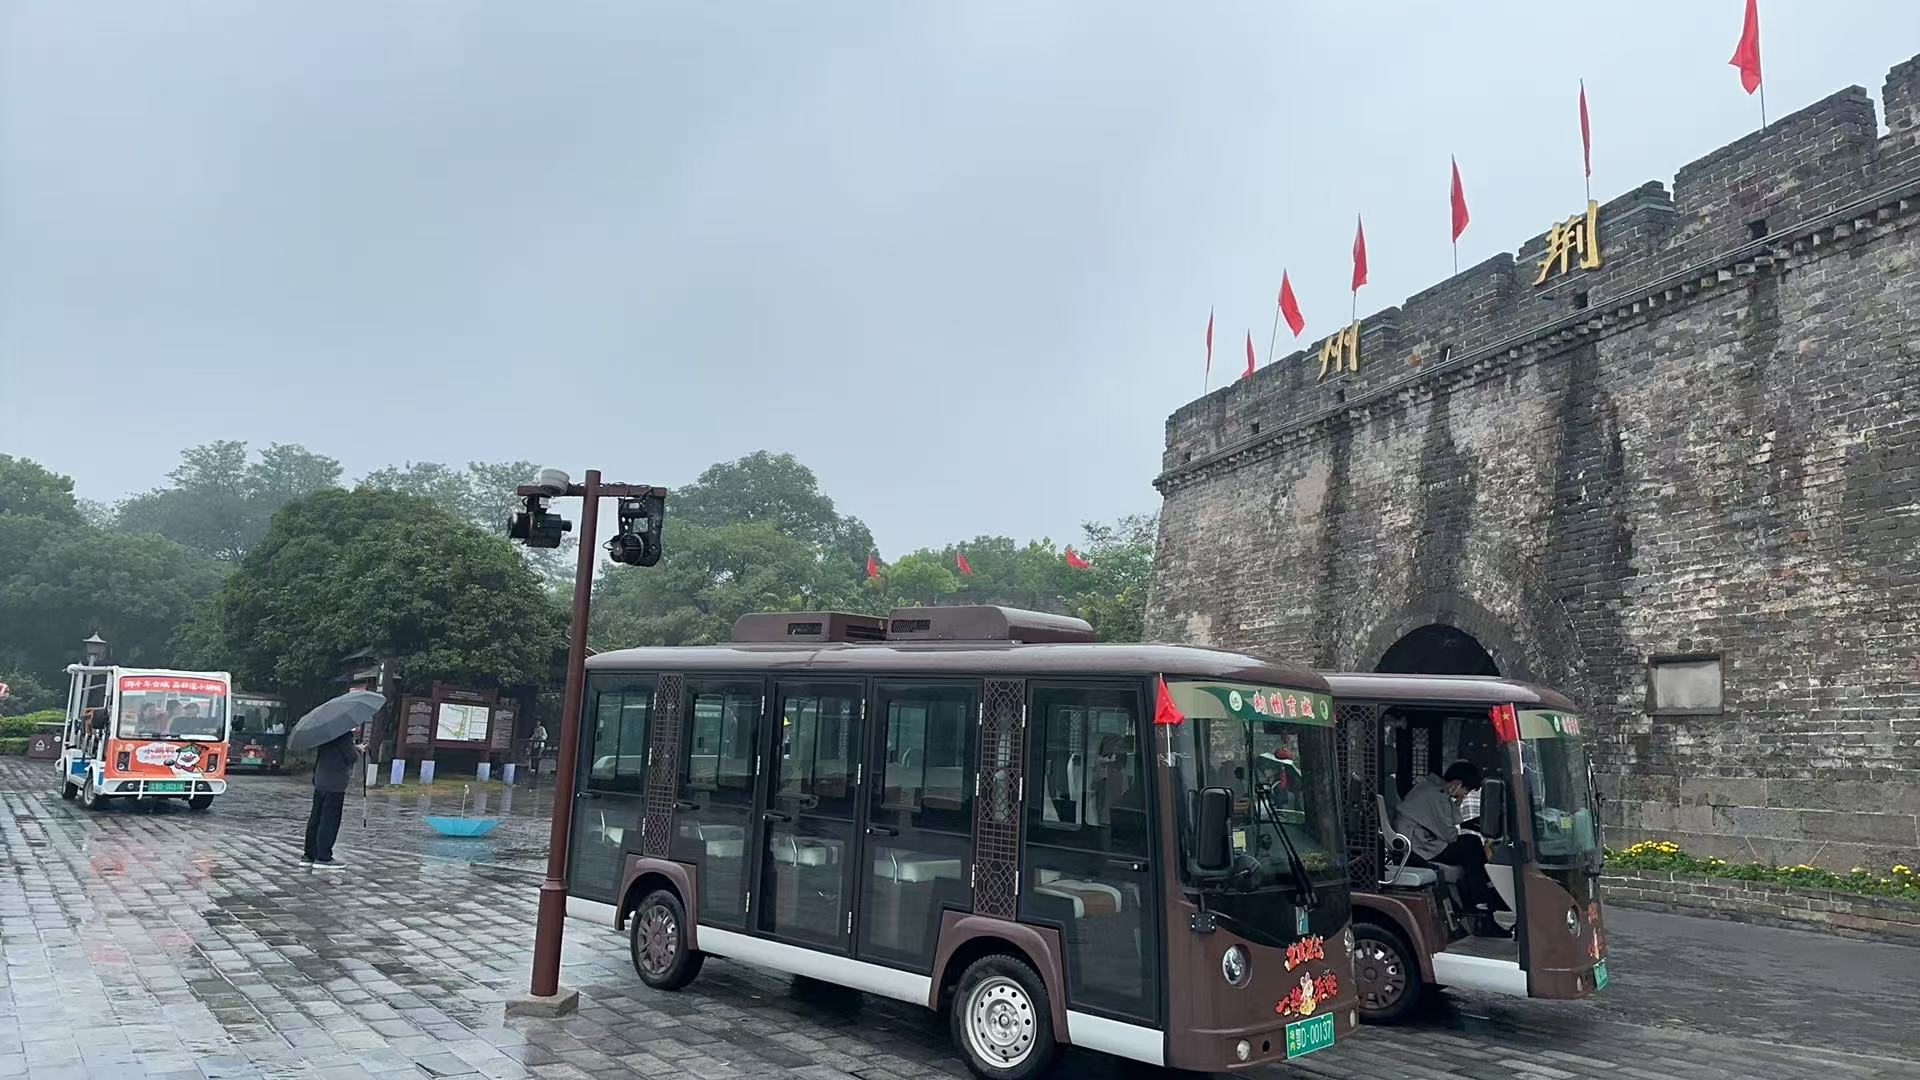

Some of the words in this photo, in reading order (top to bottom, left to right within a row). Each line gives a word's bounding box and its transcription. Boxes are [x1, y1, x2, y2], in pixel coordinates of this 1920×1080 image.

[1533, 200, 1600, 286] 荆
[1317, 319, 1361, 381] 州
[1253, 690, 1315, 720] 荆州古城
[1284, 938, 1324, 971] 2025
